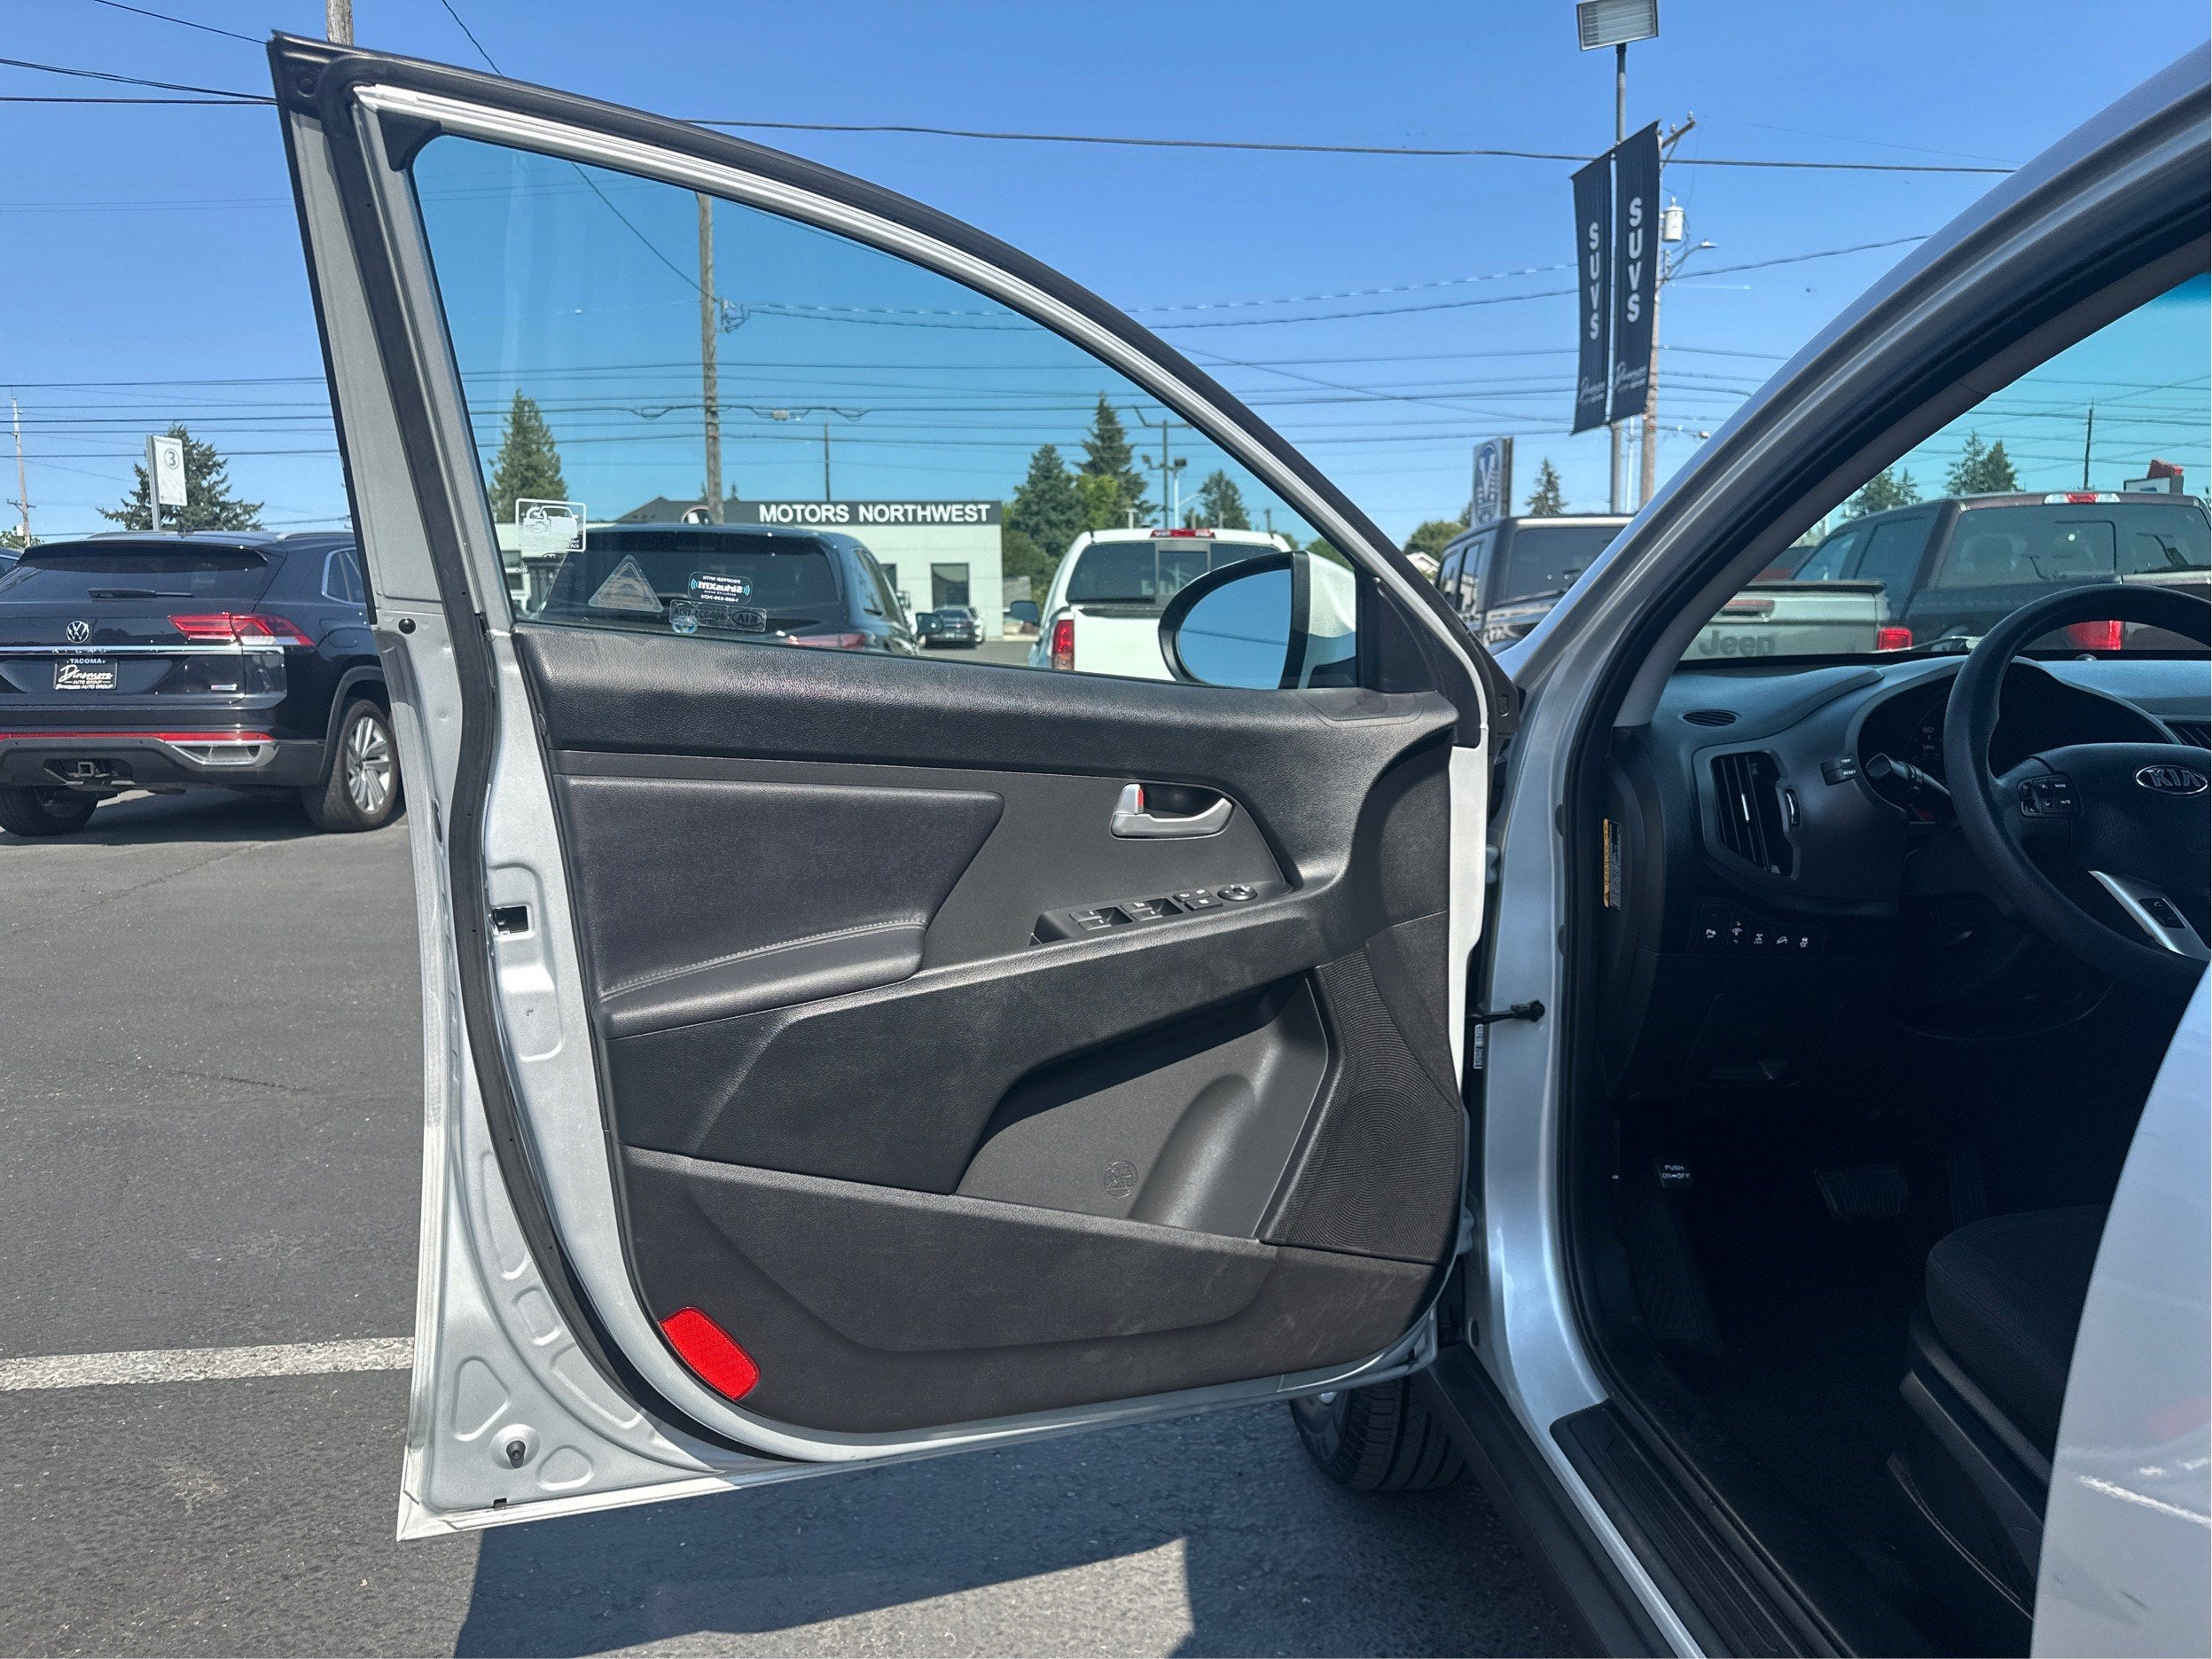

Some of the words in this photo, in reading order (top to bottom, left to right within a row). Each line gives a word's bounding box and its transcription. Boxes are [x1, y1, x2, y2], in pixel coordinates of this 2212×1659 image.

[1626, 196, 1644, 323] SUVS
[1588, 221, 1600, 340] SUVS
[168, 450, 176, 466] 3
[758, 504, 849, 523] MOTORS
[857, 503, 991, 522] NORTHWEST
[1699, 630, 1775, 656] Jeep
[2146, 768, 2201, 787] KIA
